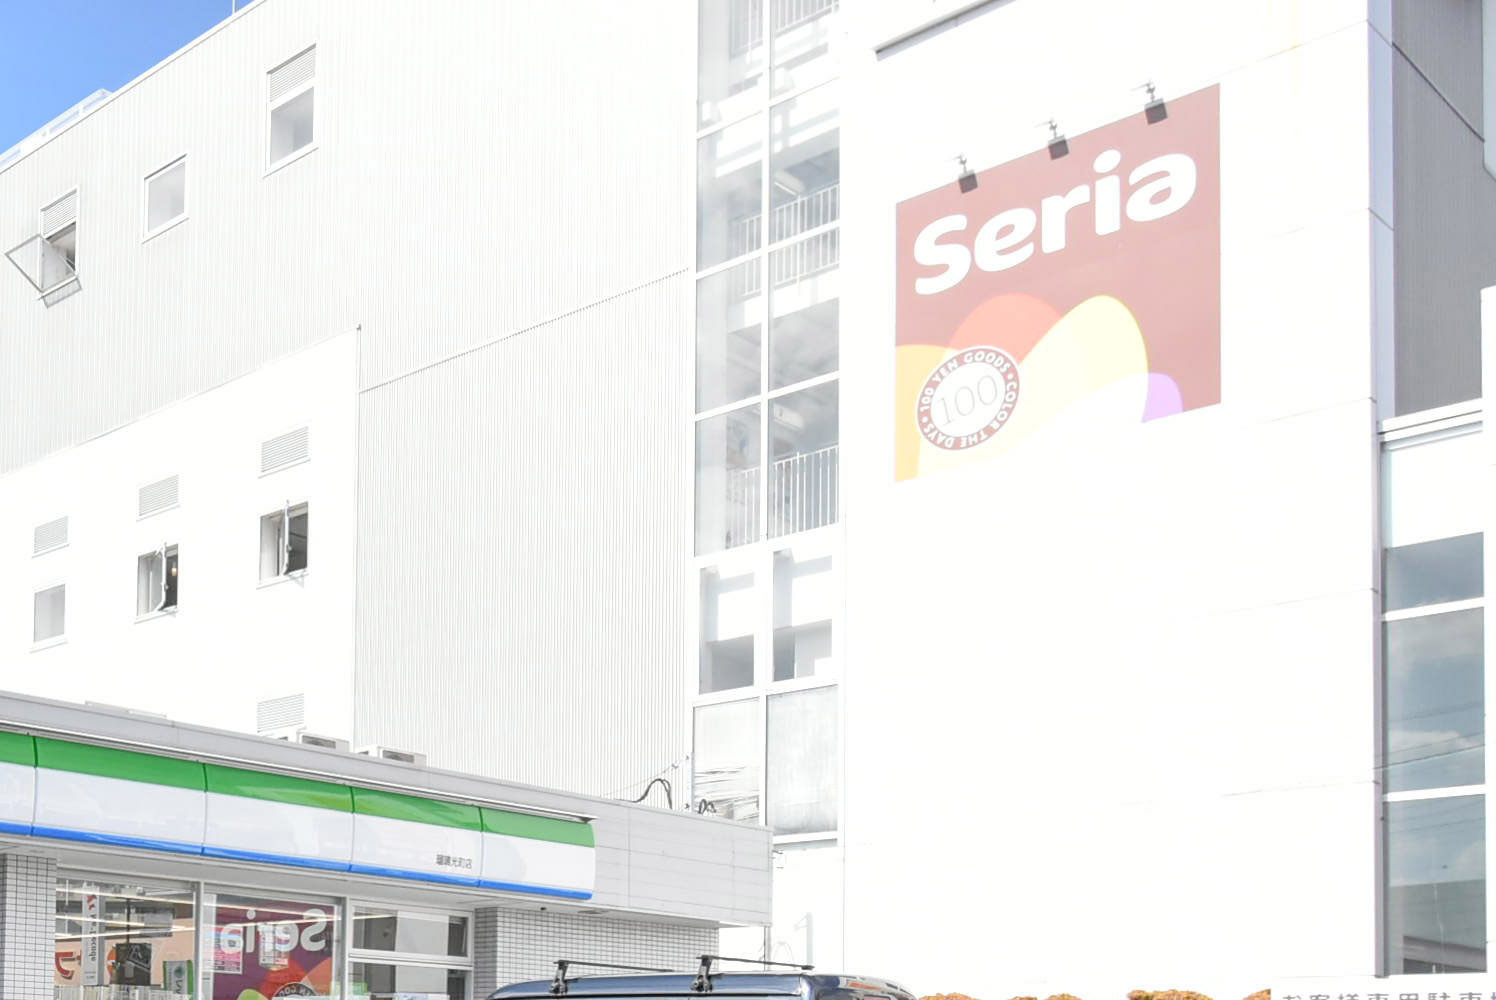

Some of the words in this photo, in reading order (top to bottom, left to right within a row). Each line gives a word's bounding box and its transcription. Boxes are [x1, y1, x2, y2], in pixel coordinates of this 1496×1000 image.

[914, 149, 1197, 295] Seria
[931, 359, 959, 383] YEN
[963, 350, 1011, 374] GOODS
